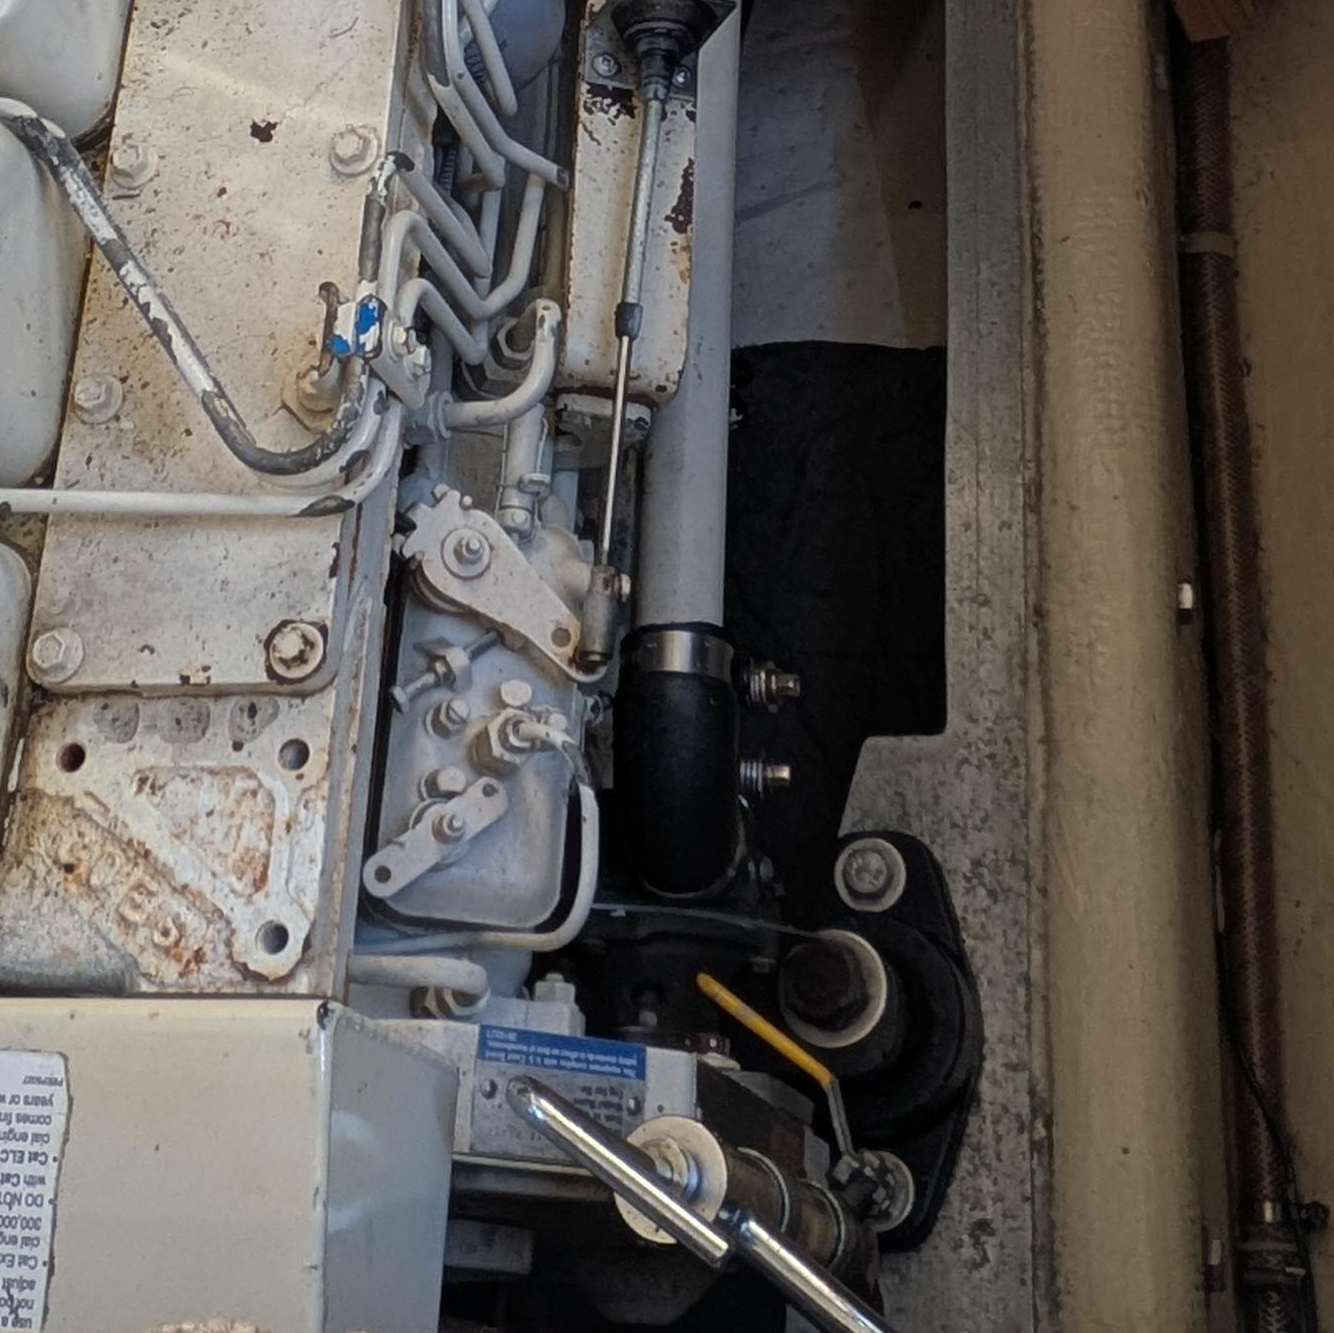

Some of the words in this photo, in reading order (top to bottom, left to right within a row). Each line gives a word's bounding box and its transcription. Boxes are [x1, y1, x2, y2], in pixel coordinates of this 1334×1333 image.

[9, 1094, 20, 1103] or
[22, 1091, 54, 1105] years
[15, 1112, 52, 1125] comes
[30, 1132, 50, 1145] cial
[0, 1149, 25, 1164] ELC
[27, 1151, 48, 1165] Cat
[0, 1172, 20, 1185] Cat
[22, 1174, 46, 1187] with
[24, 1192, 44, 1207] DO
[20, 1235, 40, 1250] cial
[16, 1254, 38, 1269] Cat
